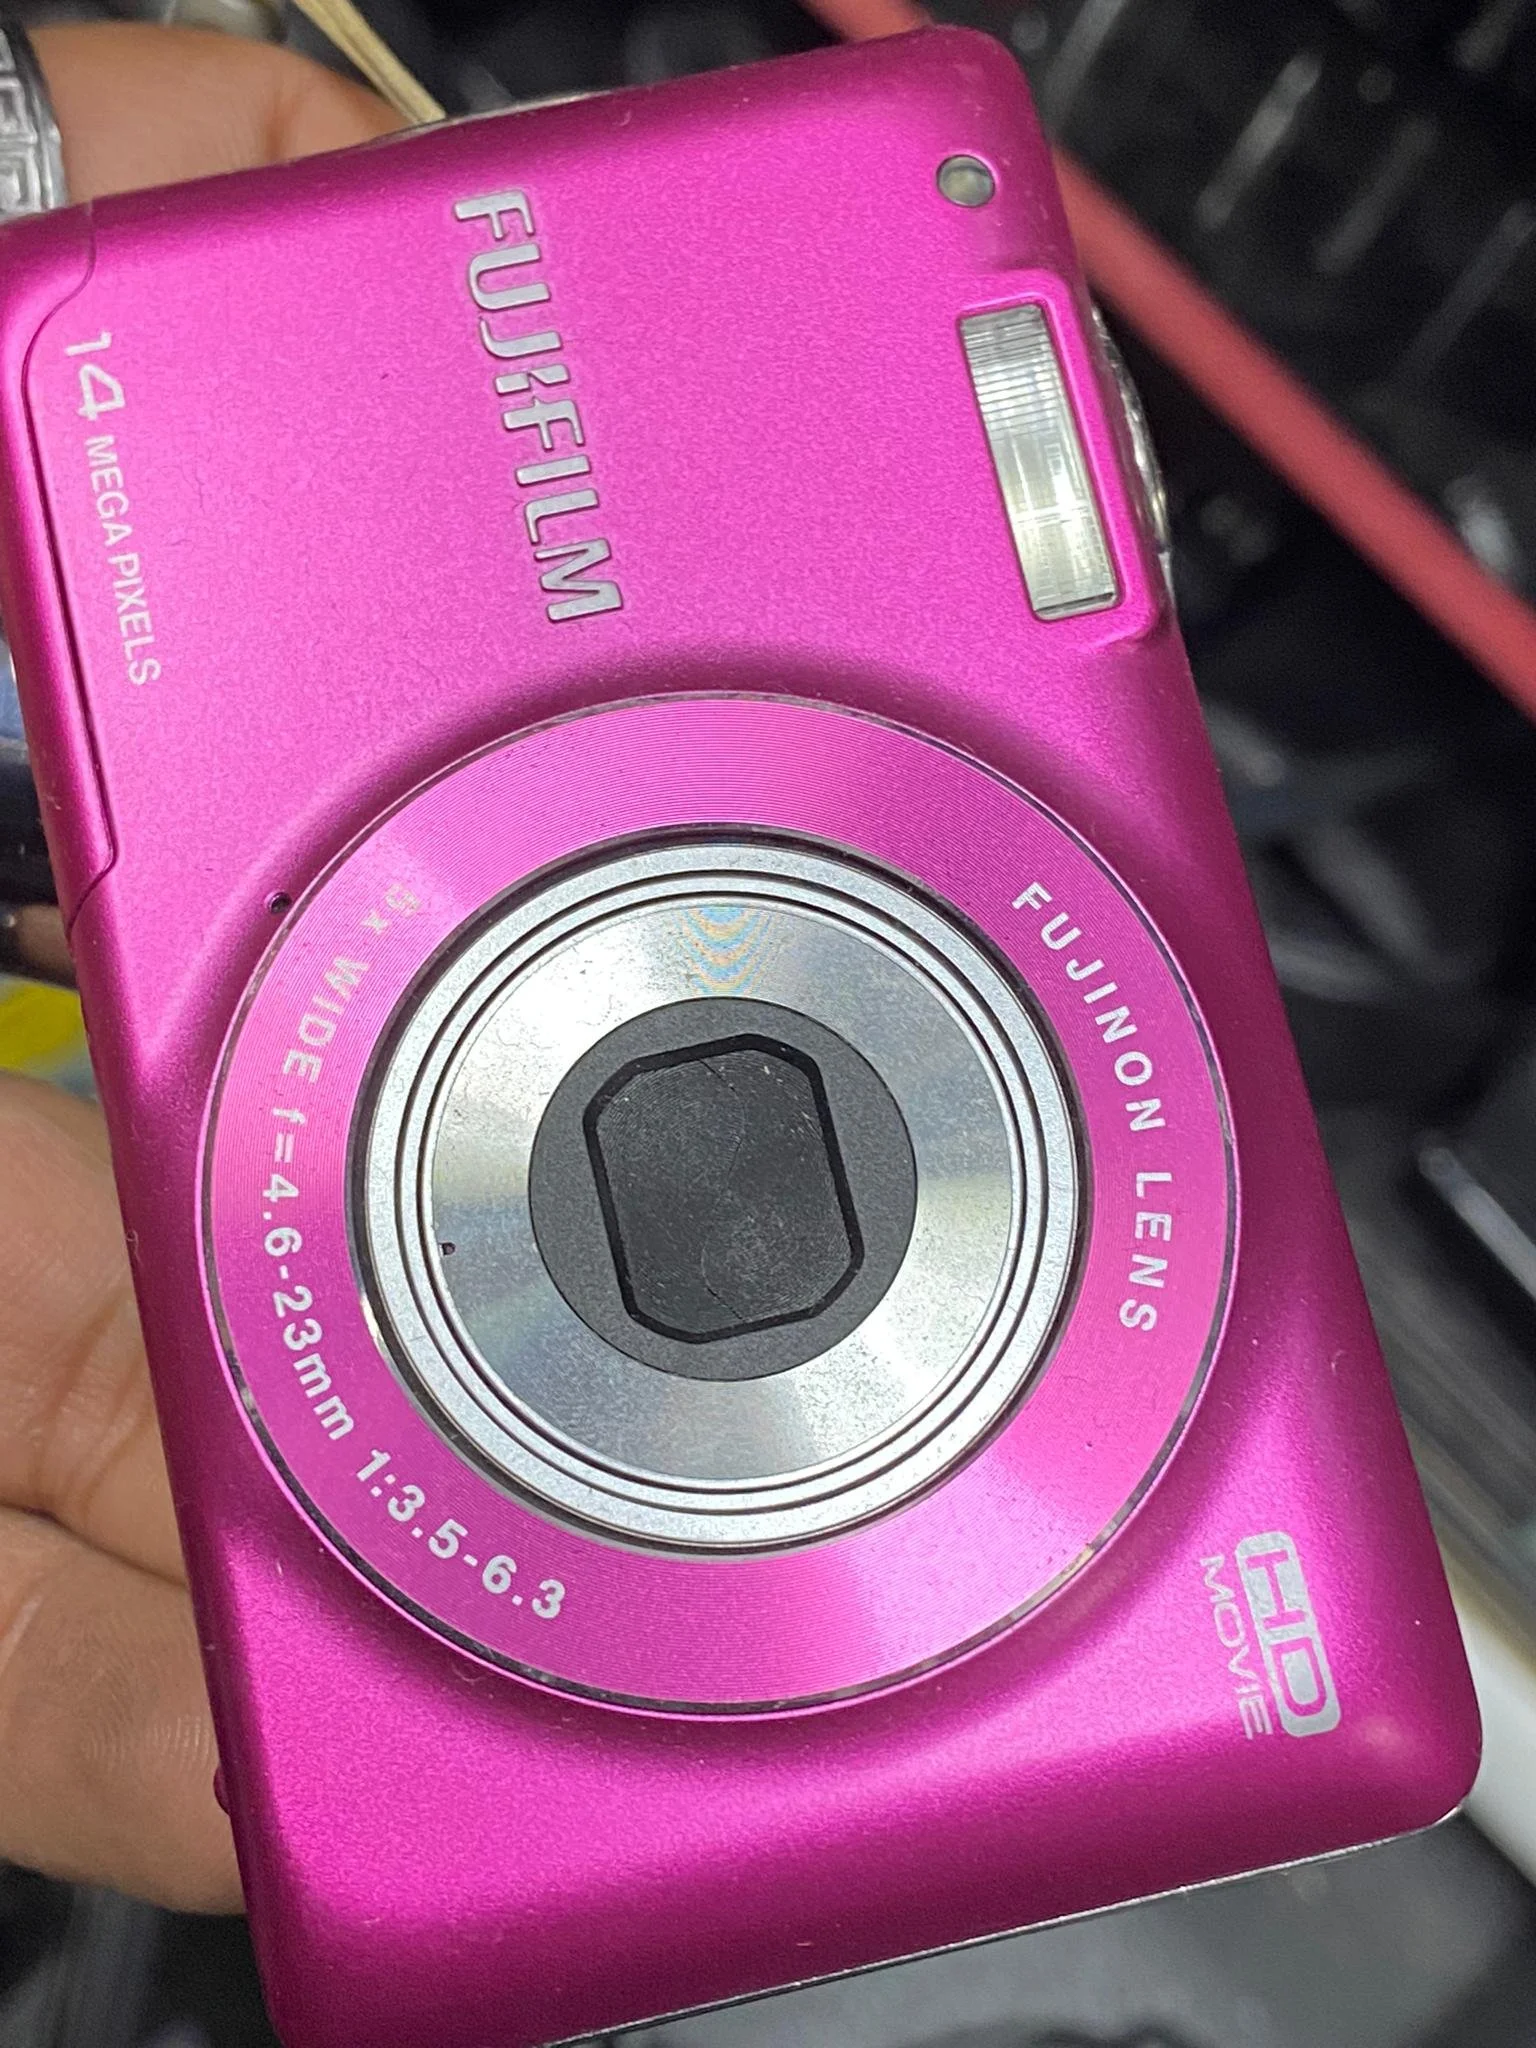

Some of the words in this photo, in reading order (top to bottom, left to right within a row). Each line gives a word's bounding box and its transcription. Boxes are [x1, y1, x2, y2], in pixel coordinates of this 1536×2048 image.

[65, 331, 126, 422] 14
[454, 189, 623, 622] FUJIFILM
[85, 435, 134, 547] MEGA
[108, 552, 162, 687] PIXELS
[282, 955, 369, 1083] WIDE
[1011, 881, 1166, 1132] FUJINON
[1118, 1171, 1173, 1332] LENS
[262, 1107, 354, 1441] f=4.6-23mm
[356, 1448, 566, 1620] 1:3.5-6.3
[1200, 1554, 1273, 1740] MOVIE
[1242, 1546, 1331, 1721] HD
